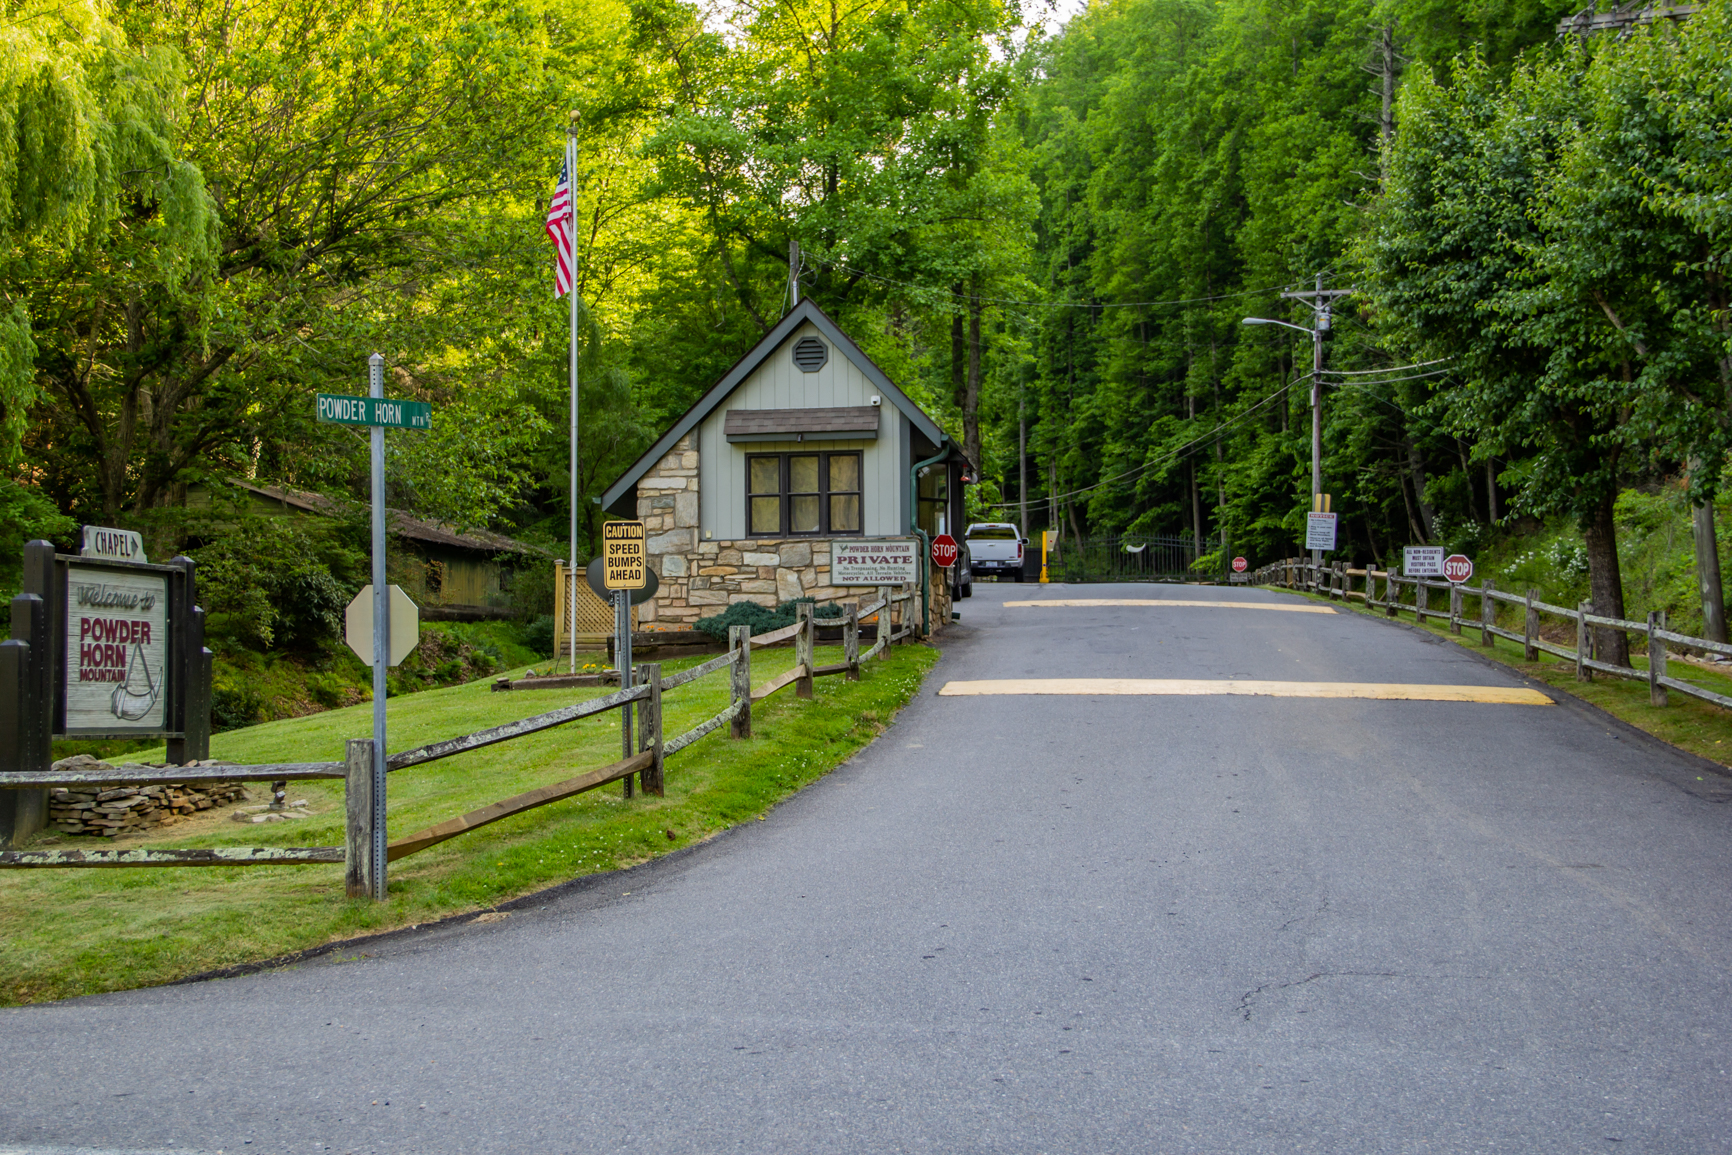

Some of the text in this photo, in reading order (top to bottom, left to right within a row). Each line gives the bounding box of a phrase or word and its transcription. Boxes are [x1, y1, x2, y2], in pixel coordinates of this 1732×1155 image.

[319, 398, 366, 421] POWDER
[375, 403, 401, 424] HORN
[412, 416, 424, 426] MTN
[606, 526, 642, 538] CAUTION
[95, 531, 131, 557] CHAPEL
[609, 544, 640, 554] SPEED
[934, 544, 956, 557] STOP
[608, 556, 642, 567] BUMPS
[836, 556, 912, 564] PRIVATE
[609, 570, 641, 580] AHEAD
[1446, 562, 1469, 576] STOP
[77, 584, 156, 611] Welcome to
[80, 617, 151, 645] POWDER
[80, 643, 127, 668] HORN
[80, 668, 126, 682] MOUNTAIN
